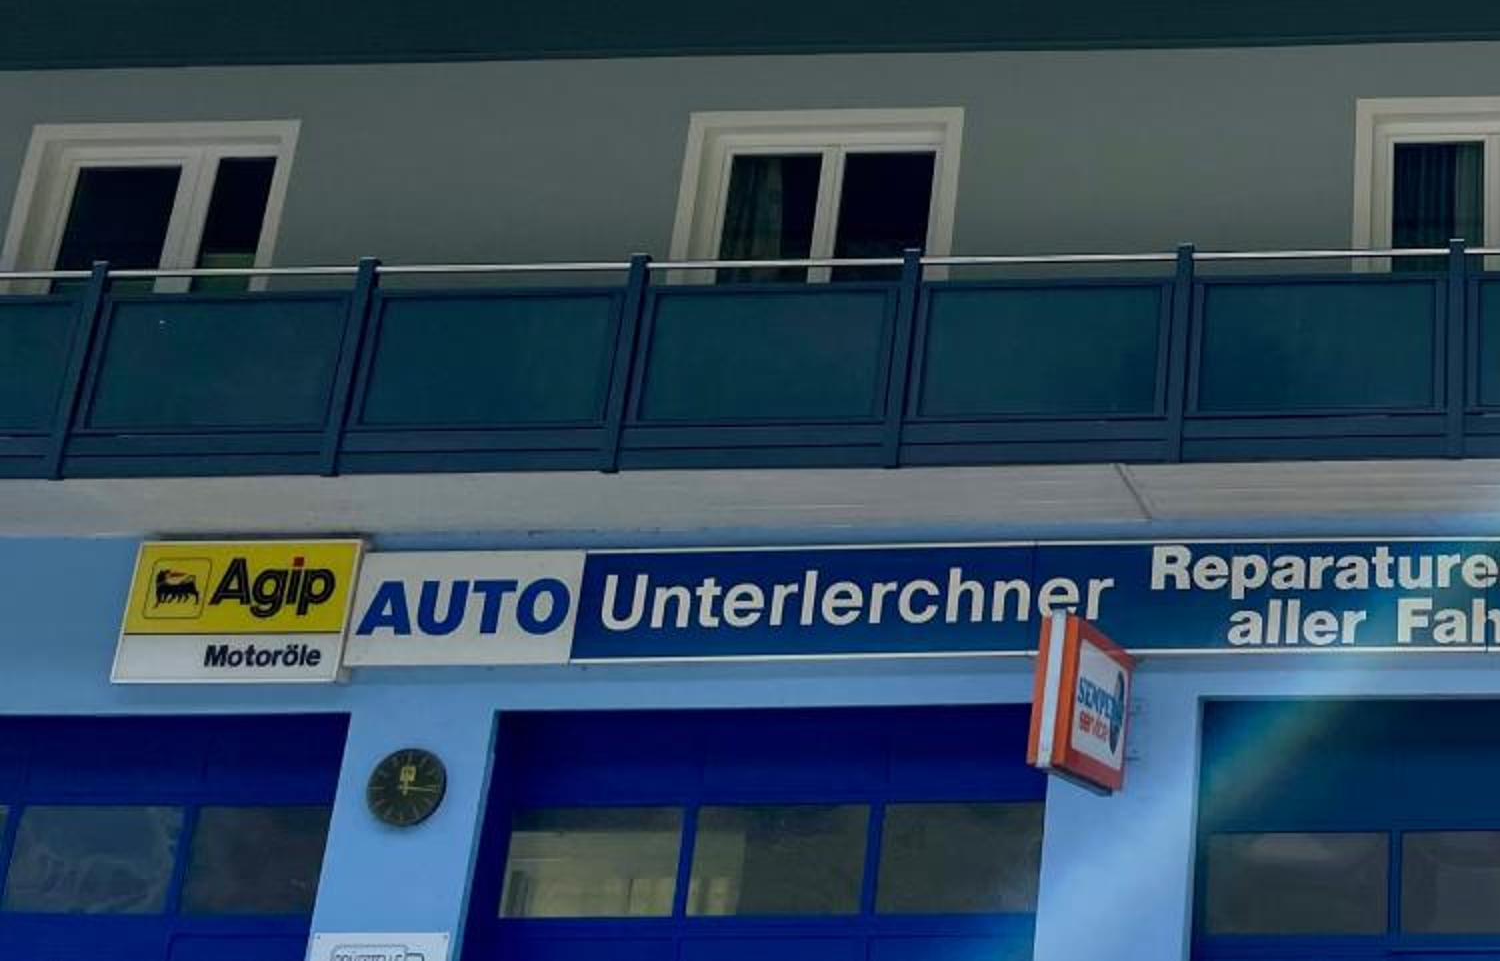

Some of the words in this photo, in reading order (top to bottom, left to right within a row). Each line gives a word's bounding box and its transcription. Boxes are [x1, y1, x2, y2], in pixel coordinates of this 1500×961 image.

[208, 556, 336, 619] Agip
[355, 576, 571, 636] AUTO
[599, 566, 1115, 631] Unterlerchner
[1226, 599, 1367, 646] aller
[203, 642, 322, 668] Motoröle
